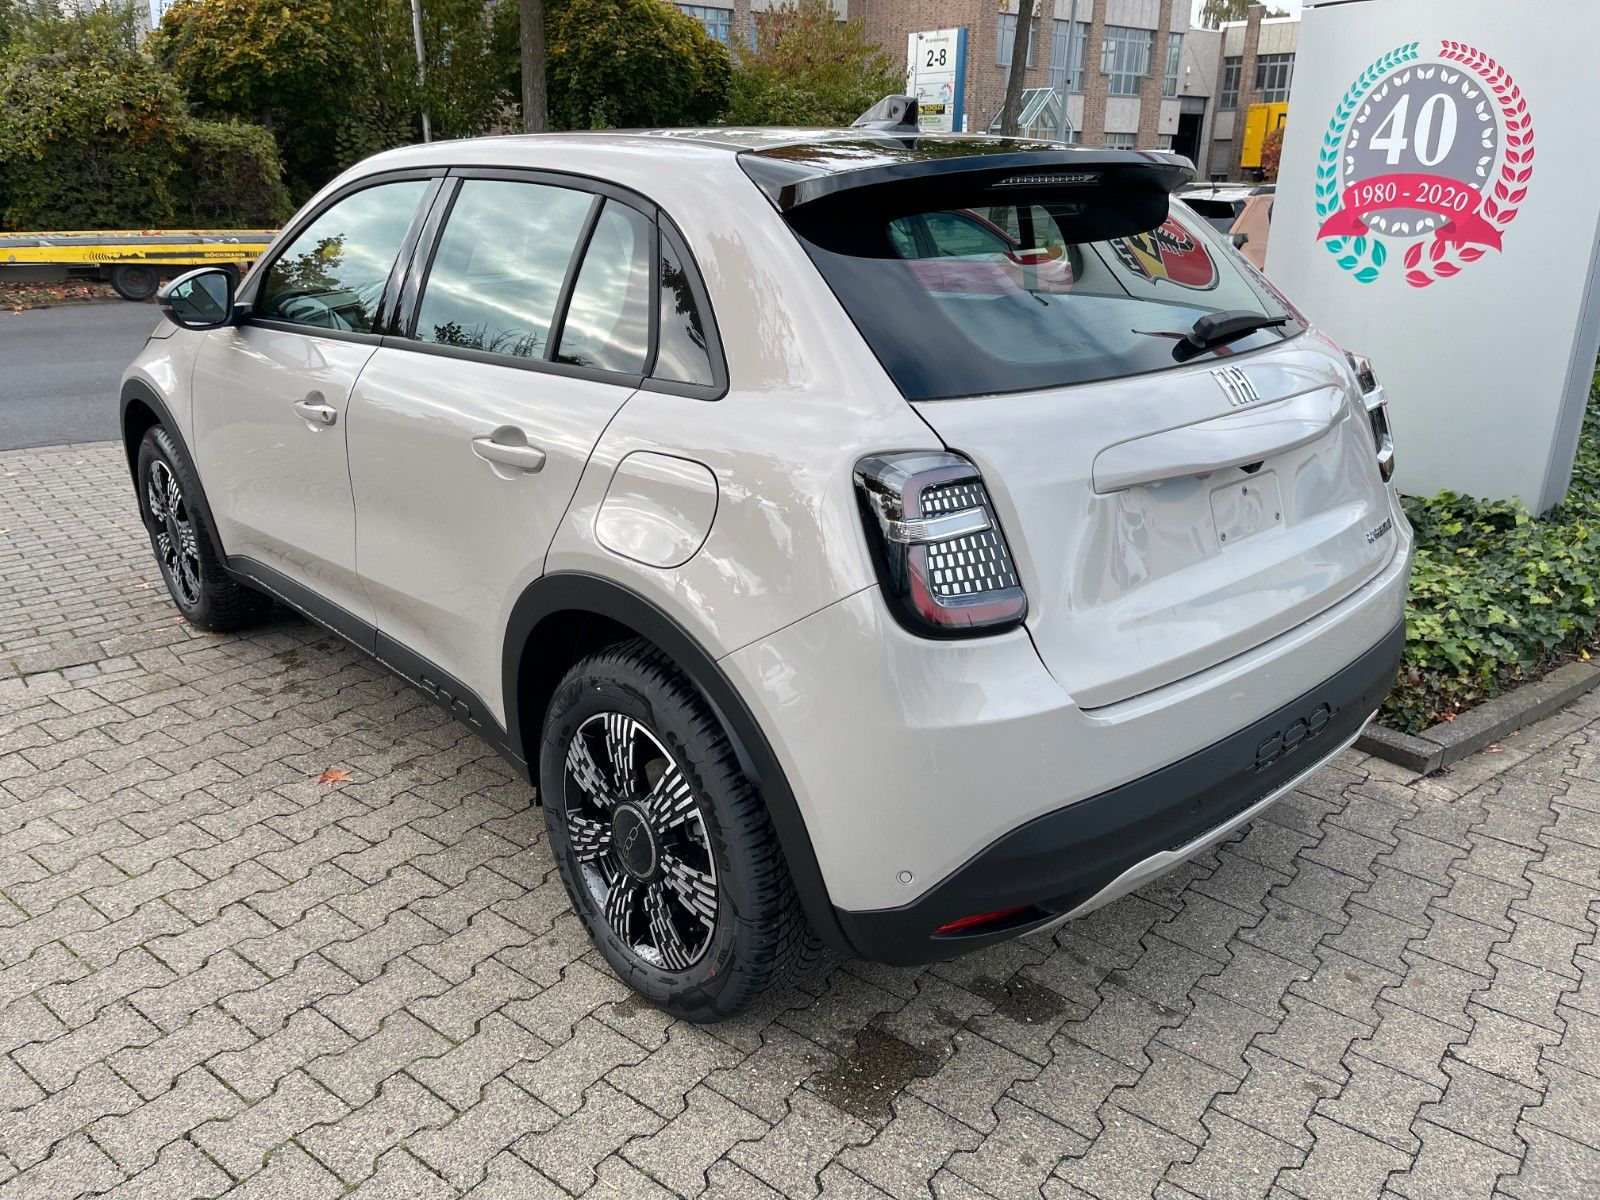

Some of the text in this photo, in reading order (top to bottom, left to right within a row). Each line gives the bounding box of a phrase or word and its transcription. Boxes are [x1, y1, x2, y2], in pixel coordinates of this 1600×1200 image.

[926, 48, 947, 67] 2-8
[1368, 93, 1458, 167] 40
[1352, 182, 1397, 208] 1980
[1415, 182, 1469, 212] 2020
